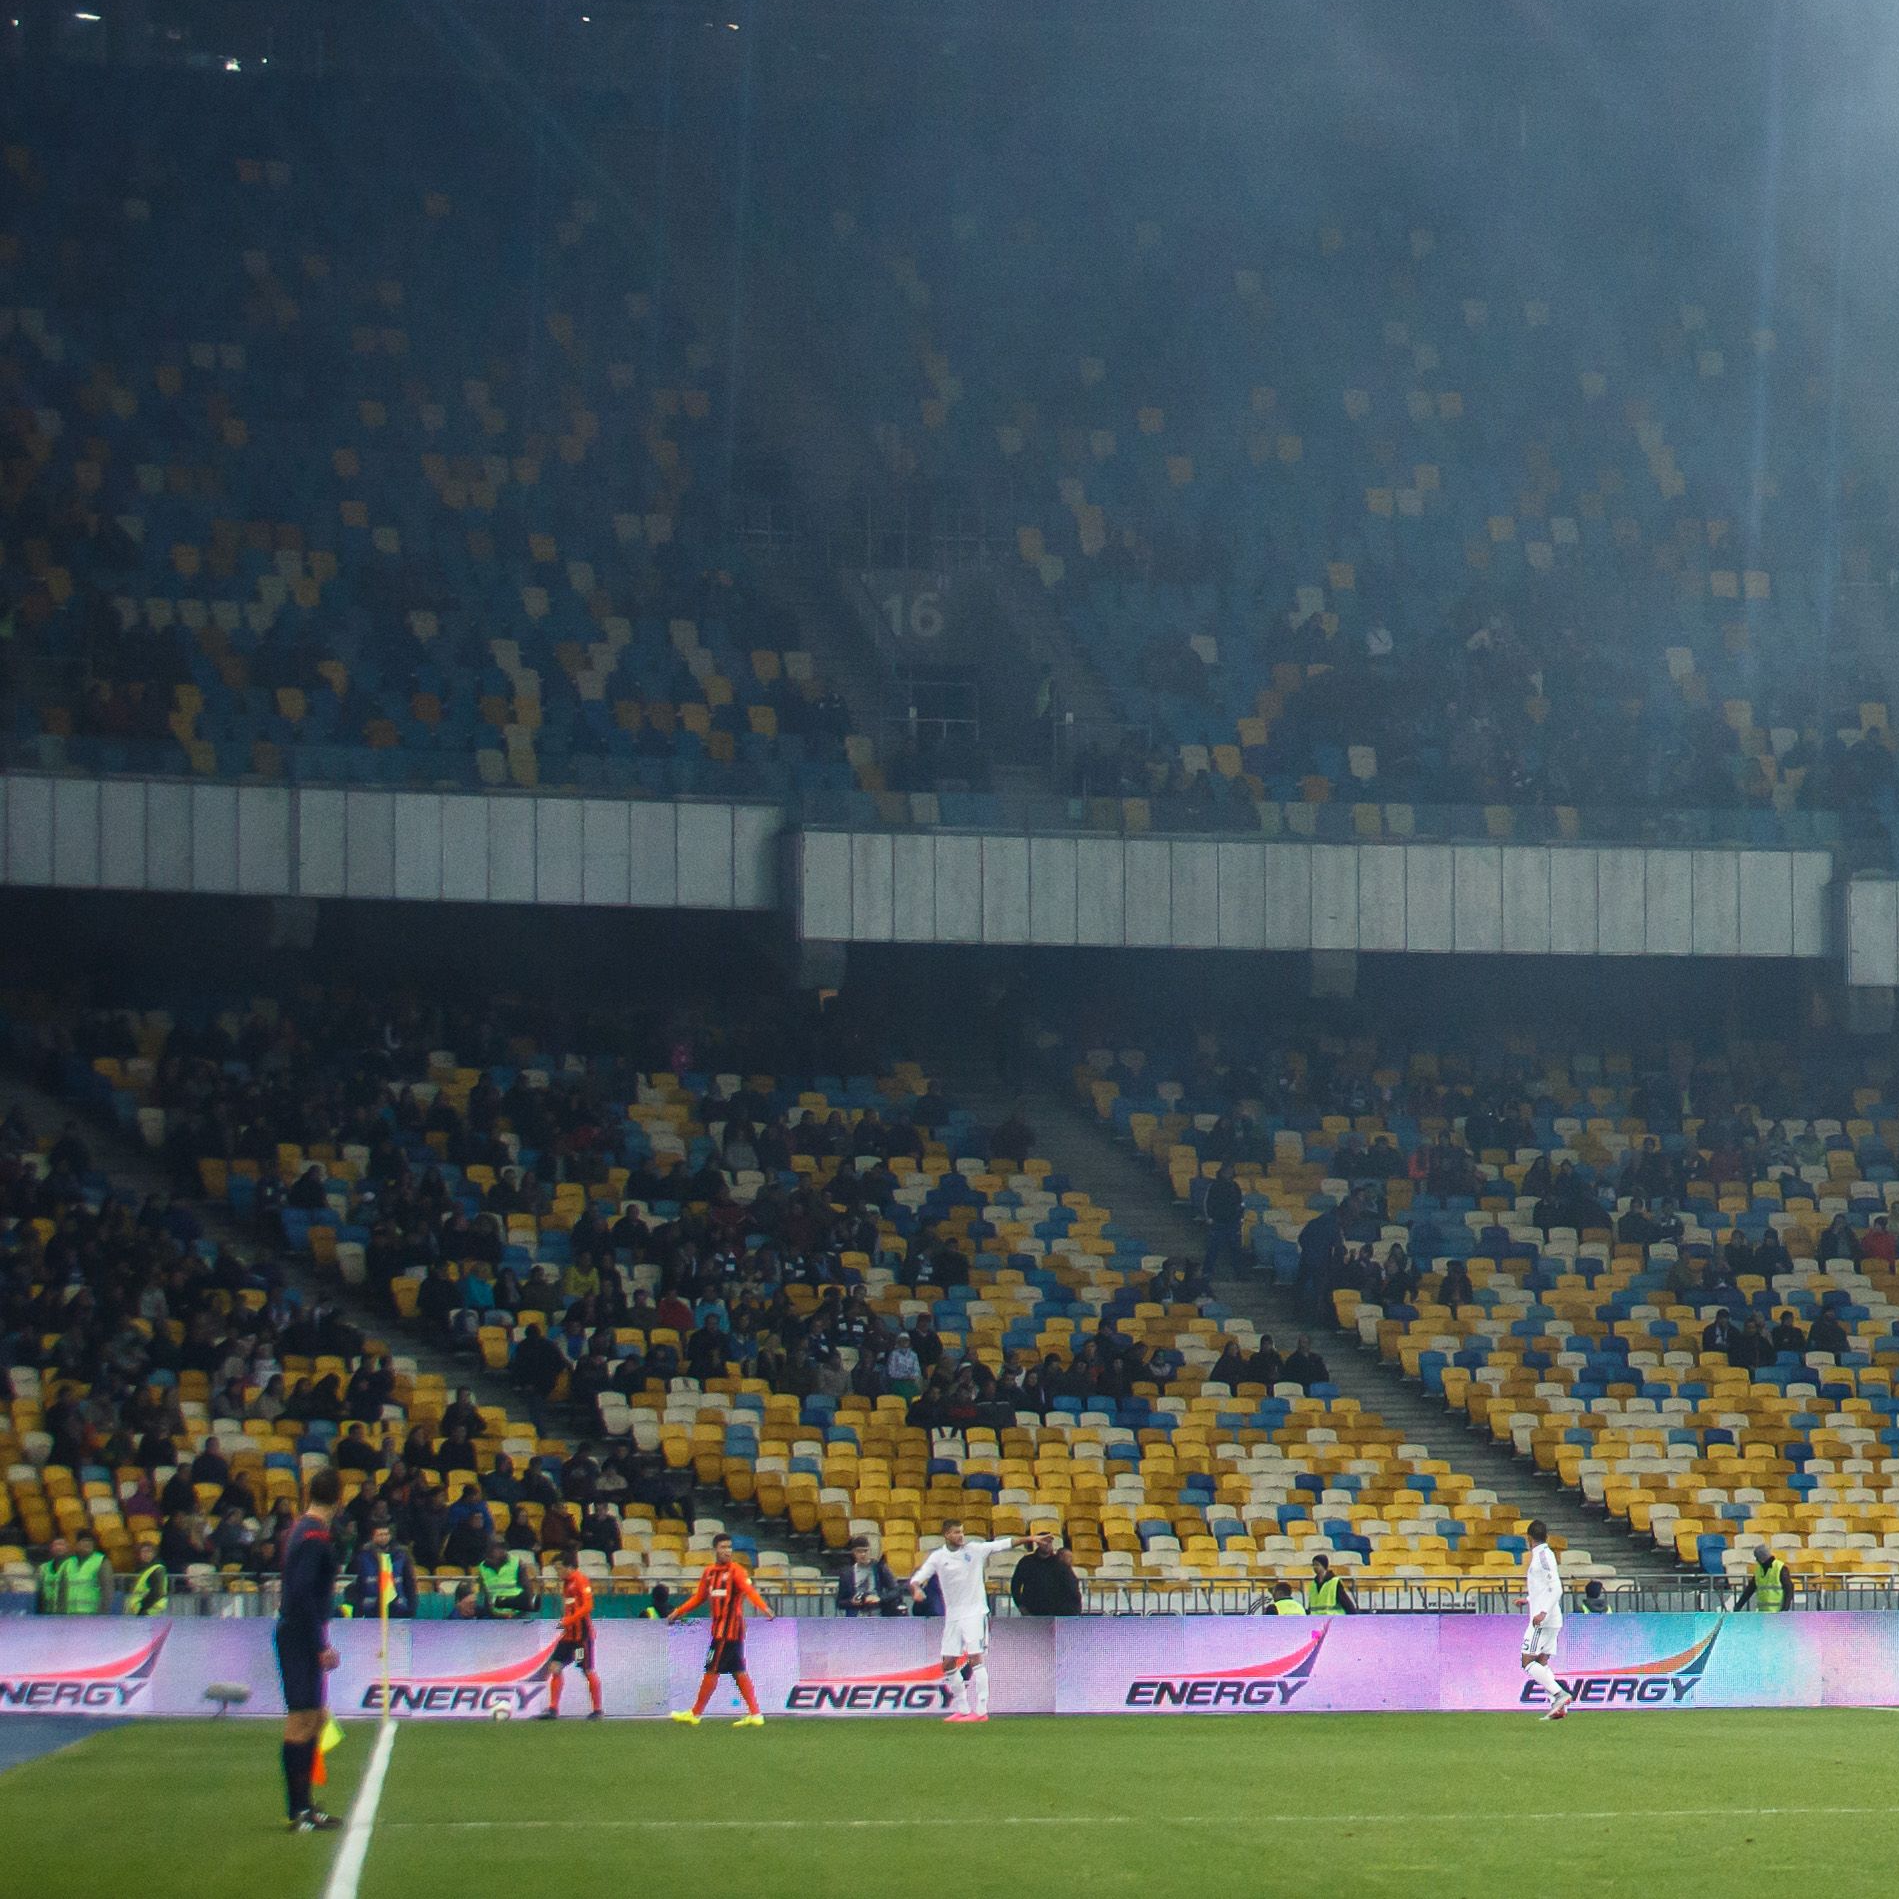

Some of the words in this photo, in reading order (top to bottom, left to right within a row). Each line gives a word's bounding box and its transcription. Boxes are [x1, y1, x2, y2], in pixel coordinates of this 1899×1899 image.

[882, 592, 945, 637] 16
[361, 1683, 546, 1711] ENERGY
[1125, 1680, 1309, 1706] ENERGY
